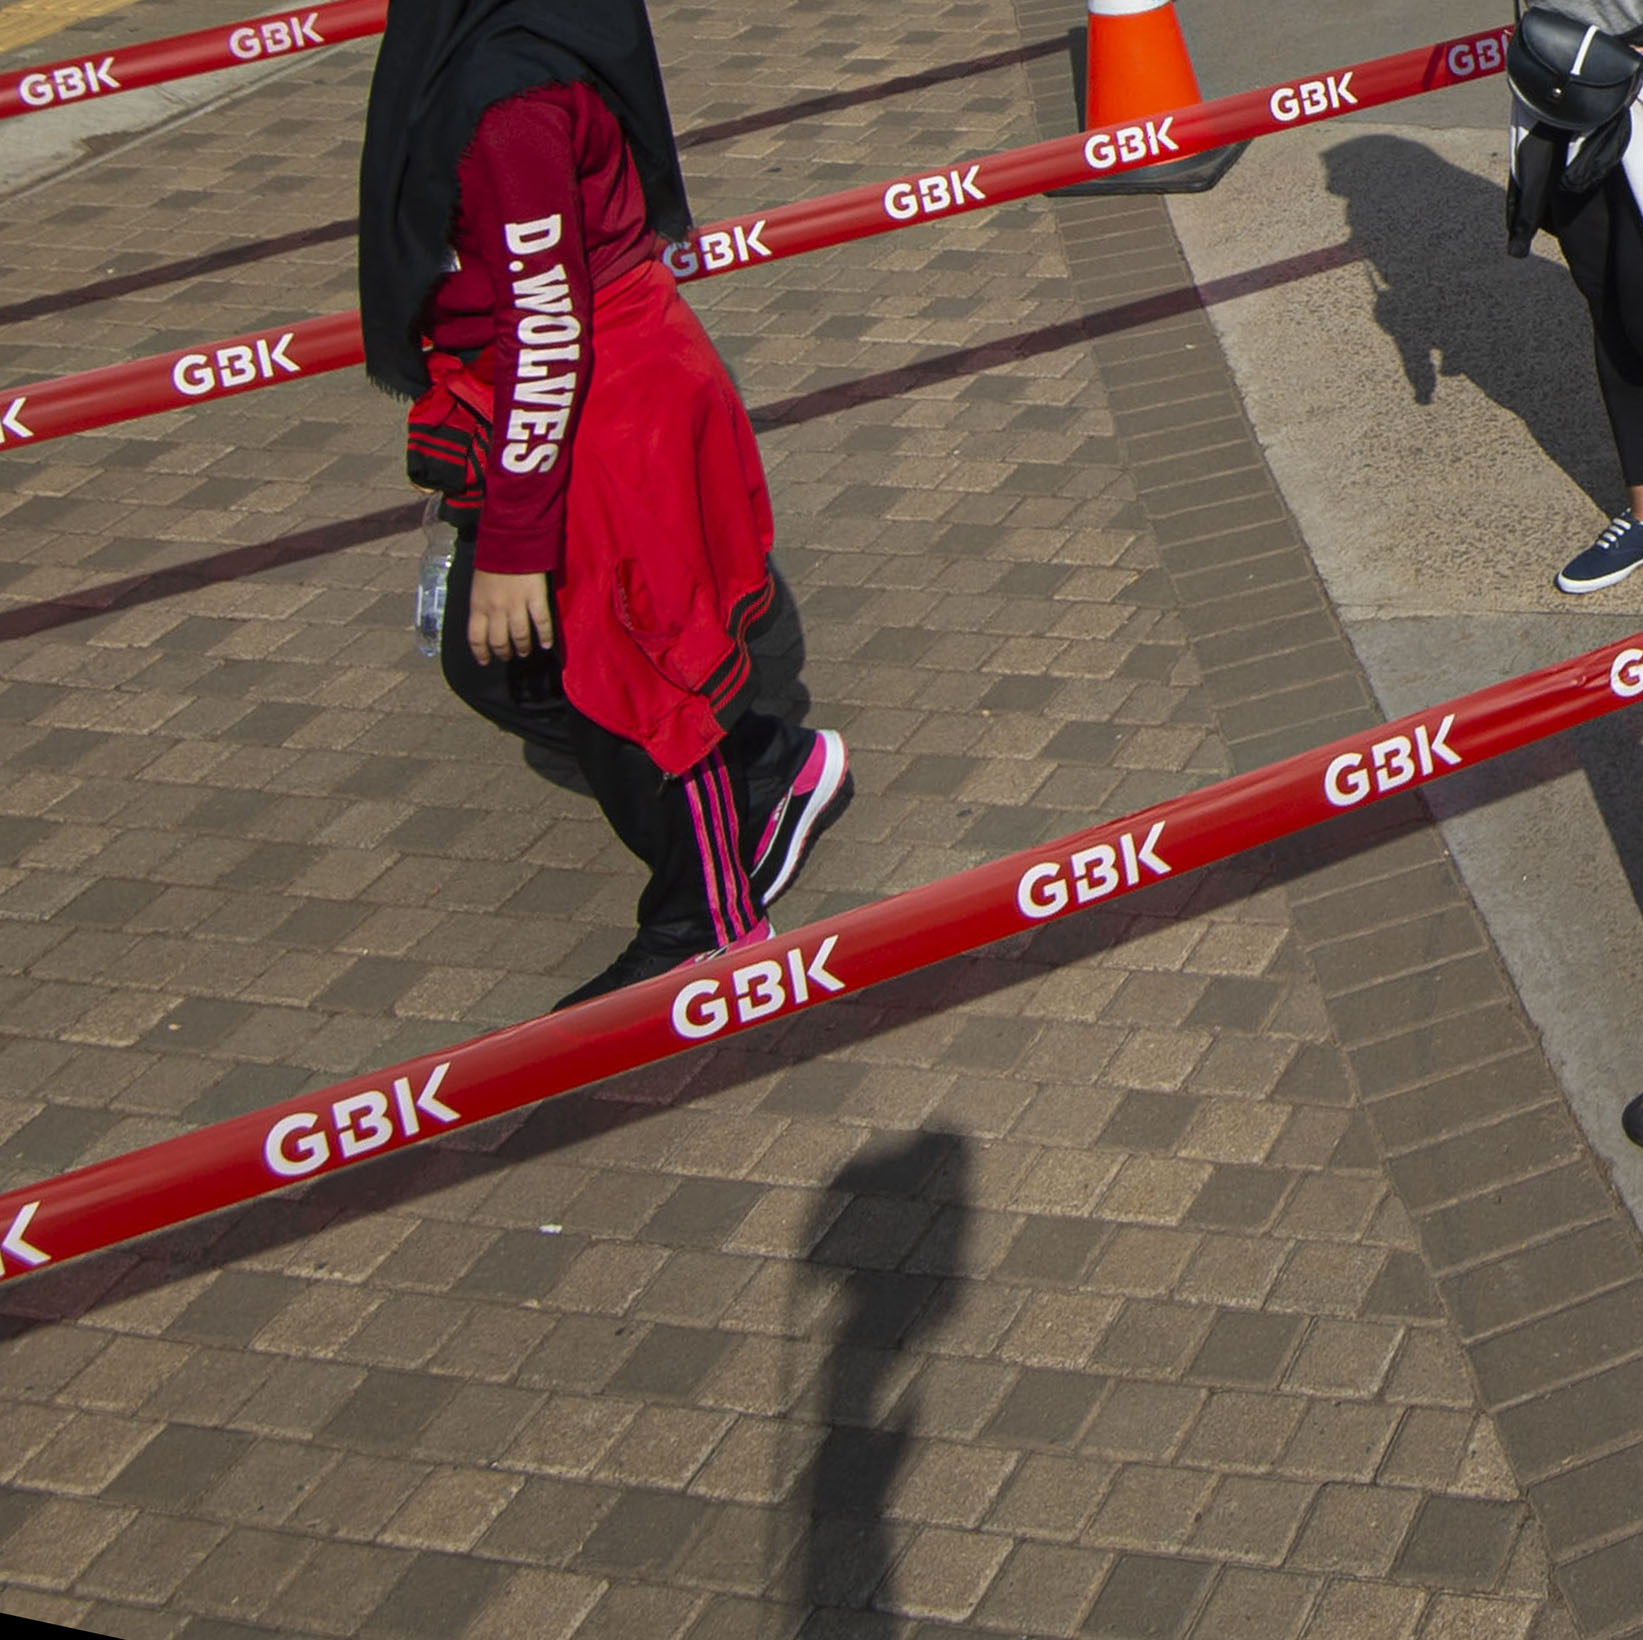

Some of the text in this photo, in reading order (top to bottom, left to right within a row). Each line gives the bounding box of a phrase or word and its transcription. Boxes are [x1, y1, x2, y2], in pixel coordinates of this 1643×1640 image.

[20, 57, 121, 109] GBK
[229, 12, 324, 60] GBK
[172, 331, 301, 397] GBK
[662, 220, 772, 279] GBK
[882, 165, 986, 221] GBK
[1084, 116, 1178, 171] GBK
[1270, 71, 1358, 122] GBK
[263, 1061, 461, 1177] GBK
[670, 935, 846, 1040] GBK
[1017, 821, 1172, 919] GBK
[1323, 714, 1462, 807] GBK
